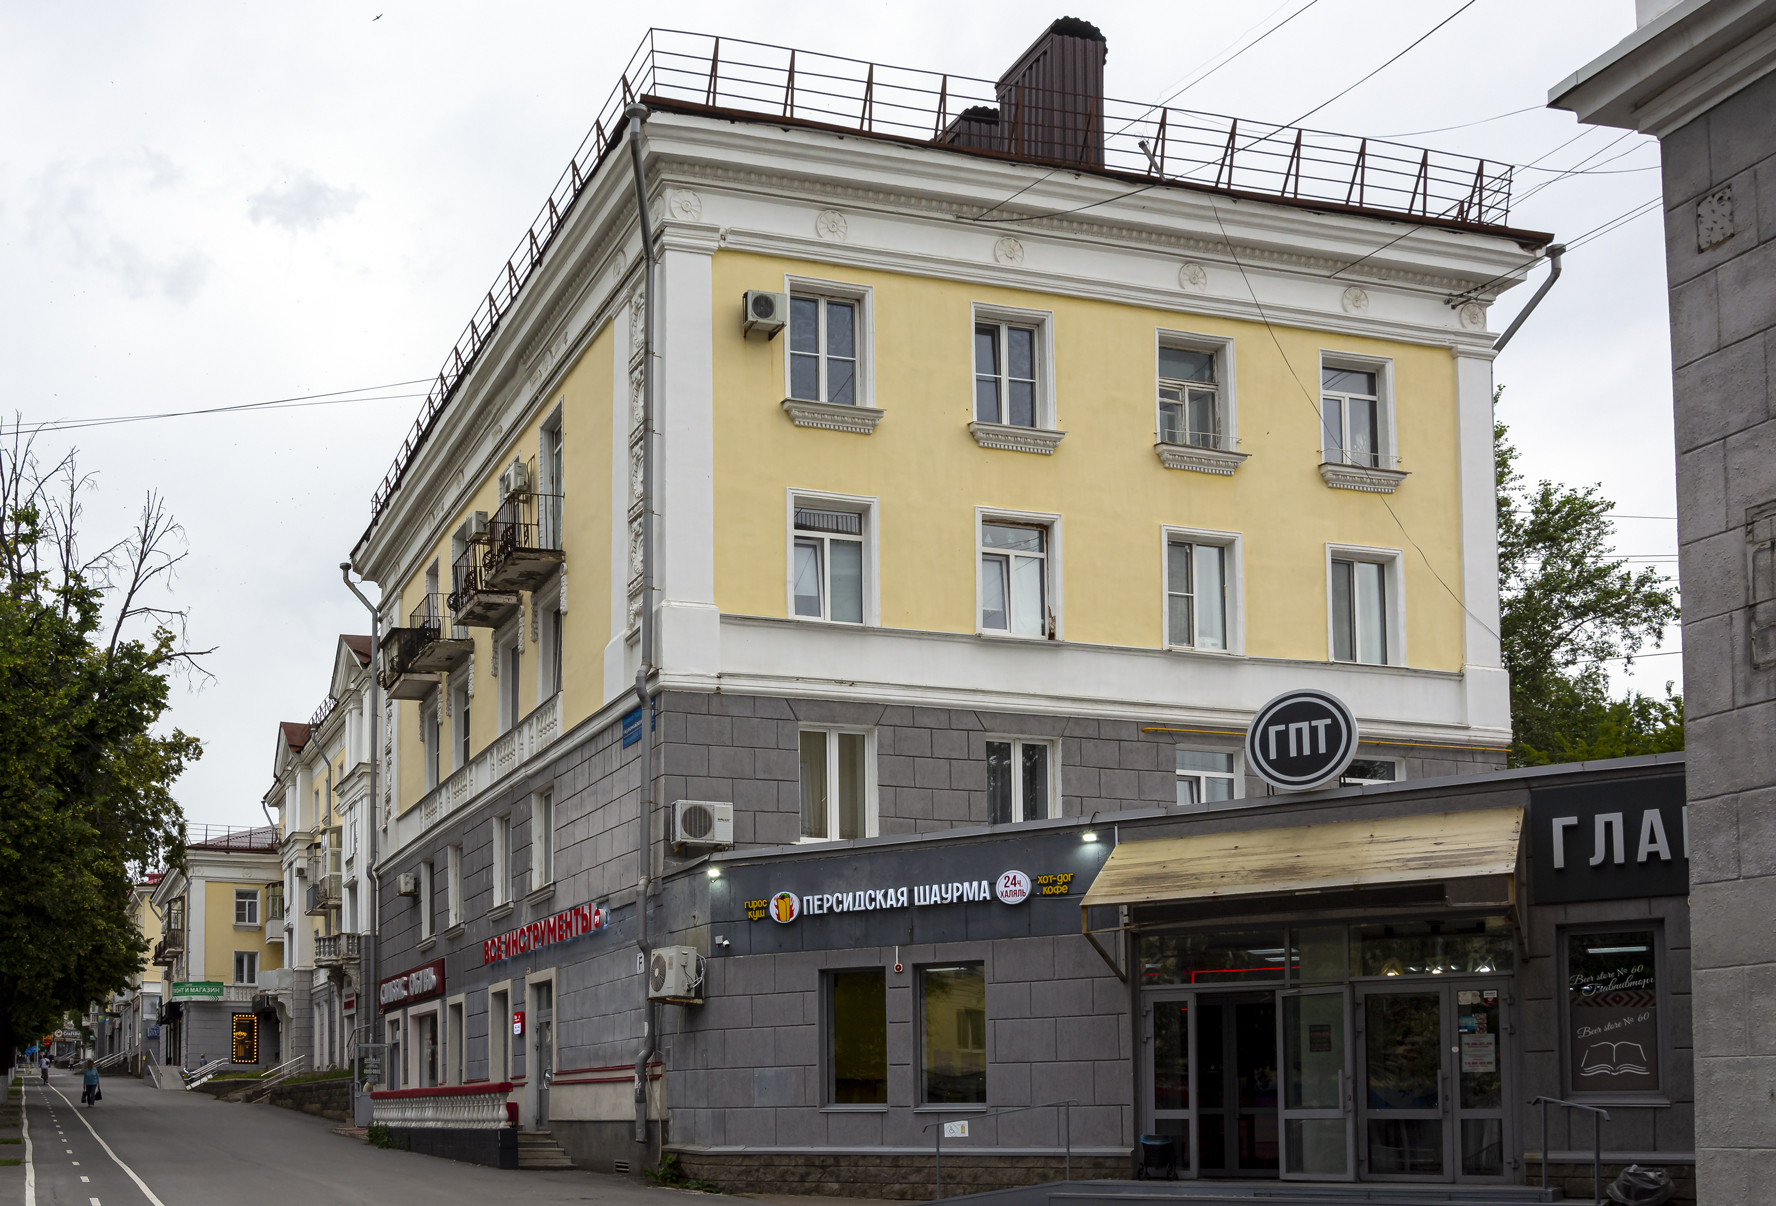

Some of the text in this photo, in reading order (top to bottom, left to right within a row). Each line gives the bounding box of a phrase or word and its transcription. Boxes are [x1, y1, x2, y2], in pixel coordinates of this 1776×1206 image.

[1268, 718, 1331, 760] ГПТ
[803, 880, 991, 916] ПЕРСИДСКАЯ ШАУРМА
[1000, 888, 1027, 899] ХАЛЯЛЬ
[1042, 885, 1069, 896] кофе
[748, 907, 766, 921] куш
[1569, 974, 1594, 986] Beer
[1596, 971, 1615, 981] store
[1631, 964, 1644, 974] 60
[1577, 1026, 1601, 1039] Beer
[1603, 1021, 1622, 1032] store
[1637, 1011, 1650, 1022] 60
